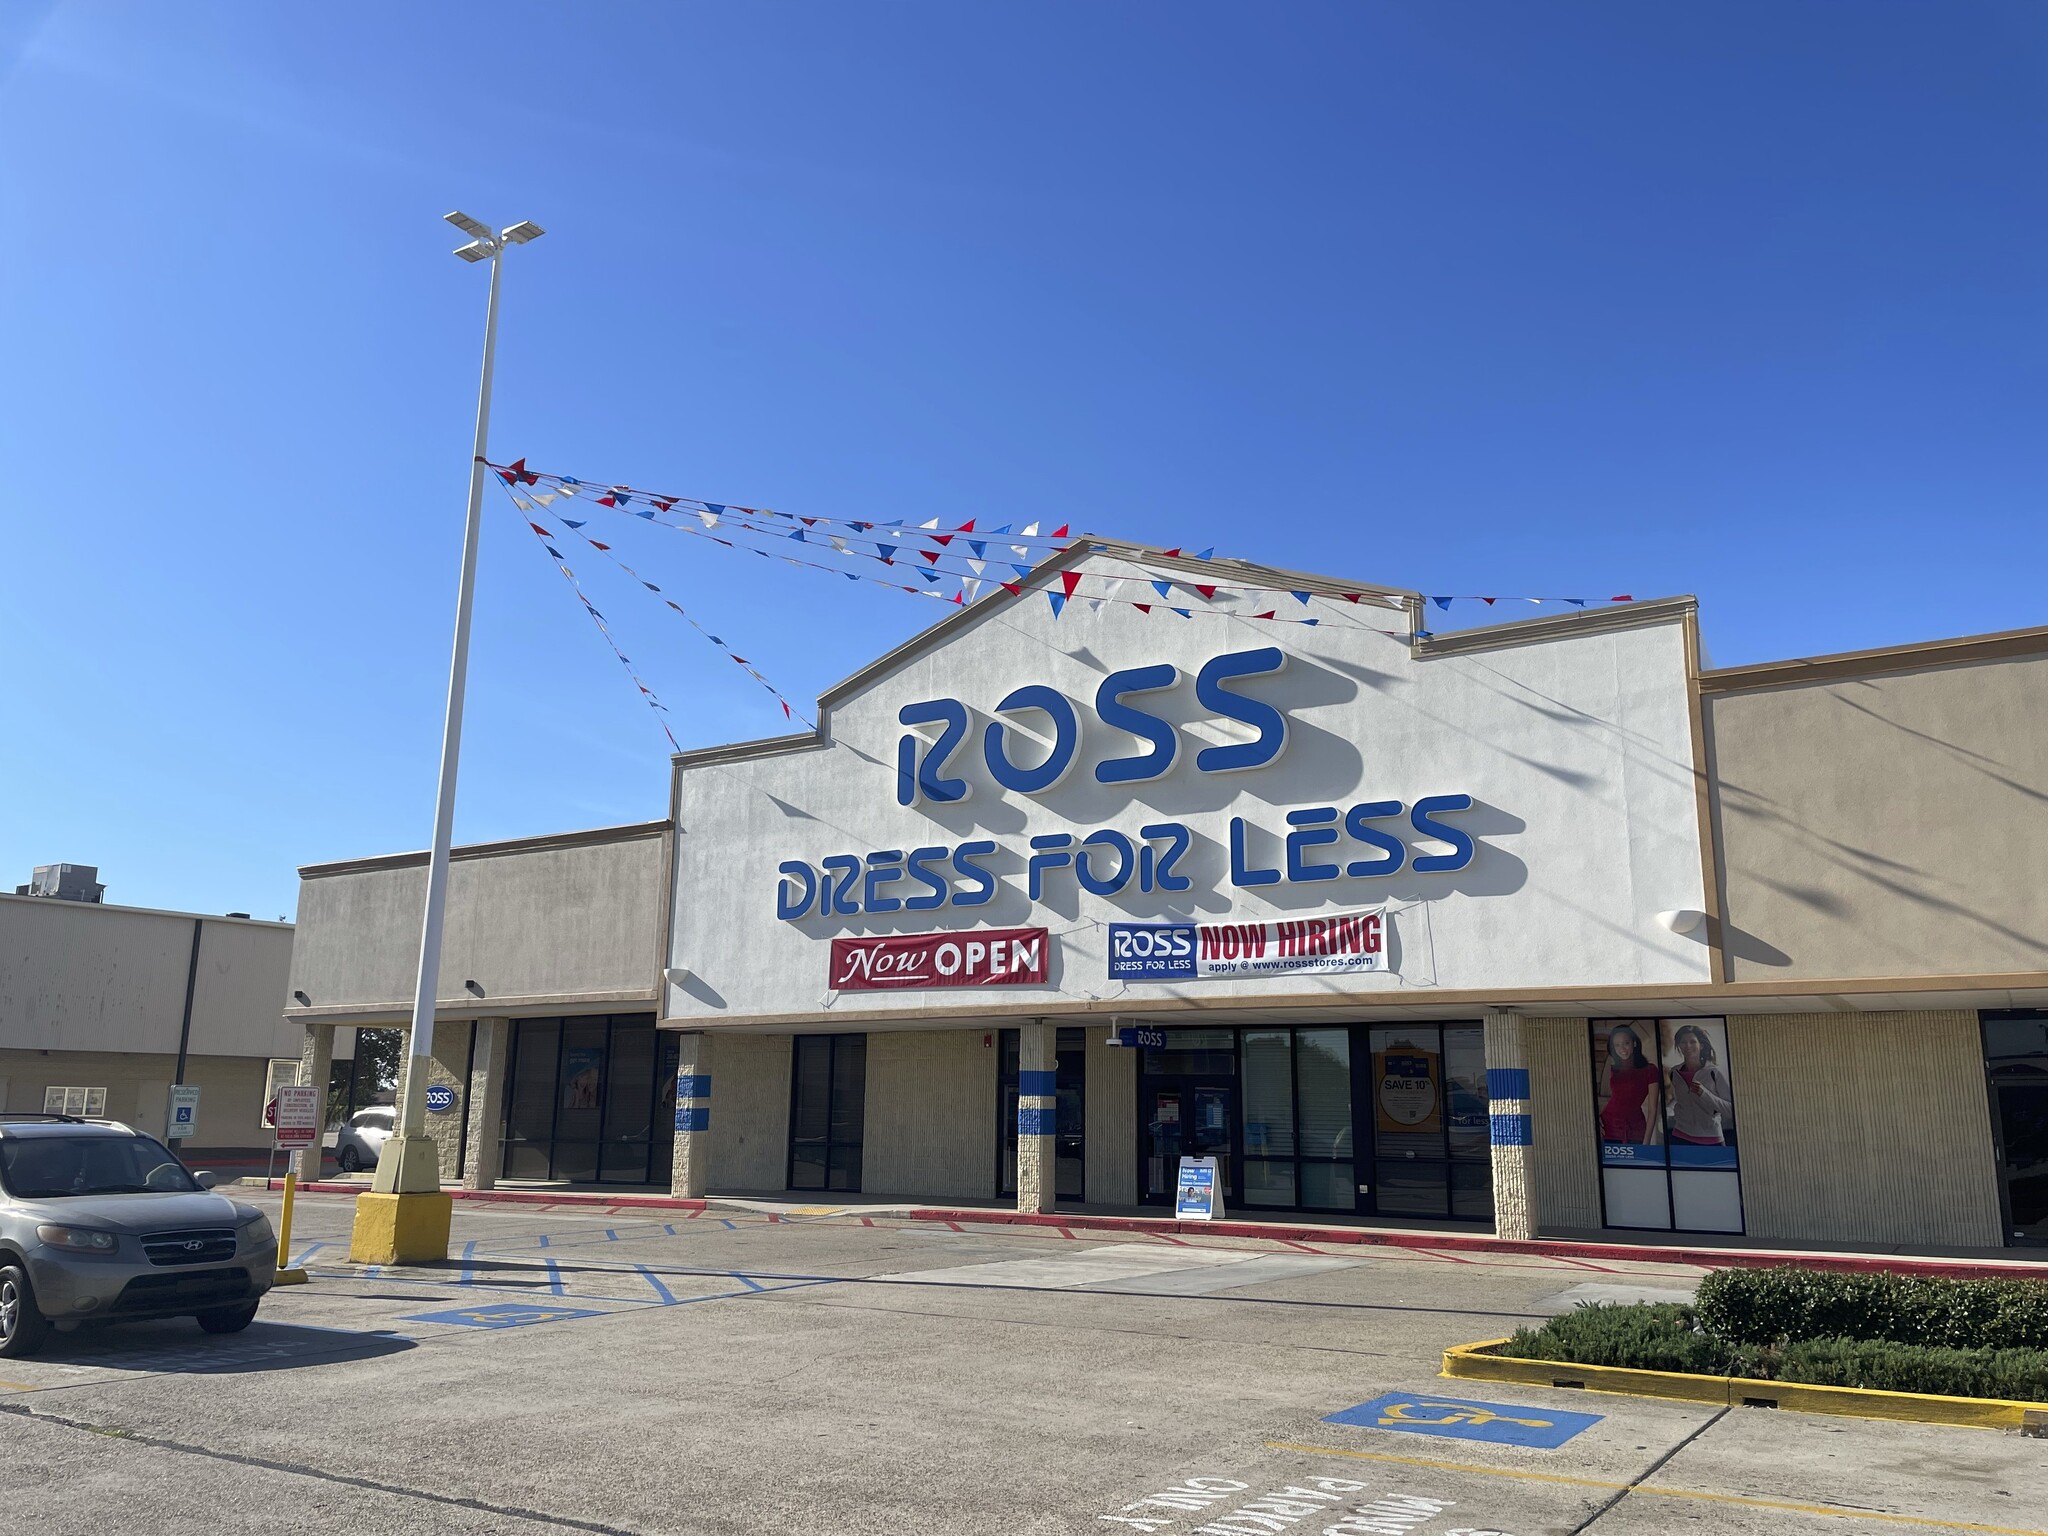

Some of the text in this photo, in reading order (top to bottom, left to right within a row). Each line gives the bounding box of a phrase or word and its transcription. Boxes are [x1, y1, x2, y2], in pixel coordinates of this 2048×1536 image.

[898, 647, 1284, 806] ROSS
[777, 794, 1473, 920] DRESS FOR LESS
[1114, 929, 1191, 957] ROSS
[1200, 915, 1382, 960] NOW HIRING
[838, 938, 1040, 983] Now OPEN
[1114, 960, 1191, 971] DRESS FOR LESS
[1208, 956, 1373, 973] apply @ www.rossstores.com
[1137, 1030, 1162, 1047] ROSS
[1384, 1080, 1413, 1090] SAVE
[1604, 1145, 1634, 1155] ROSS
